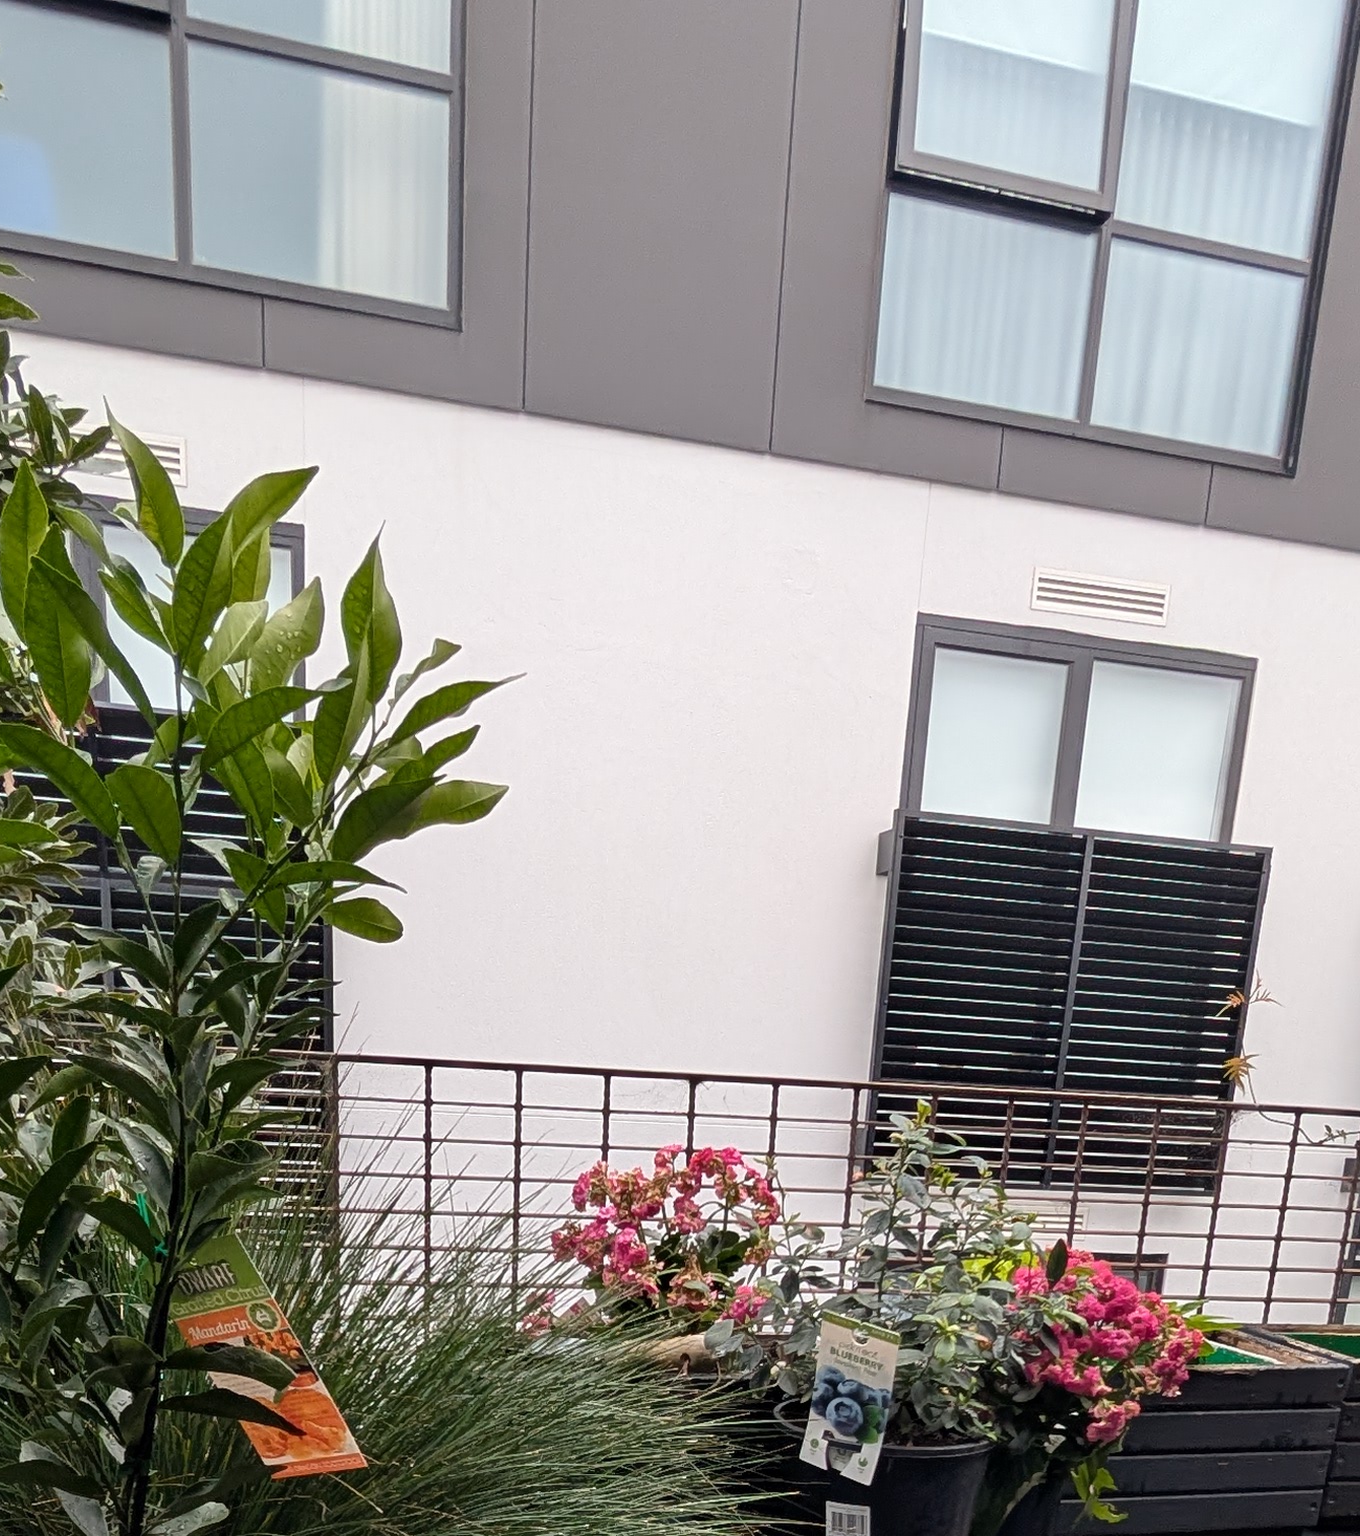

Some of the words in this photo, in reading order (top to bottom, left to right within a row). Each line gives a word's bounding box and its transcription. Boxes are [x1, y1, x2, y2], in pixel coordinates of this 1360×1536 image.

[178, 1262, 235, 1295] DWARF
[172, 1293, 224, 1315] Grafted
[225, 1285, 267, 1302] Citrus
[188, 1318, 251, 1340] Mandarin
[830, 1346, 884, 1371] BLUEBERRY
